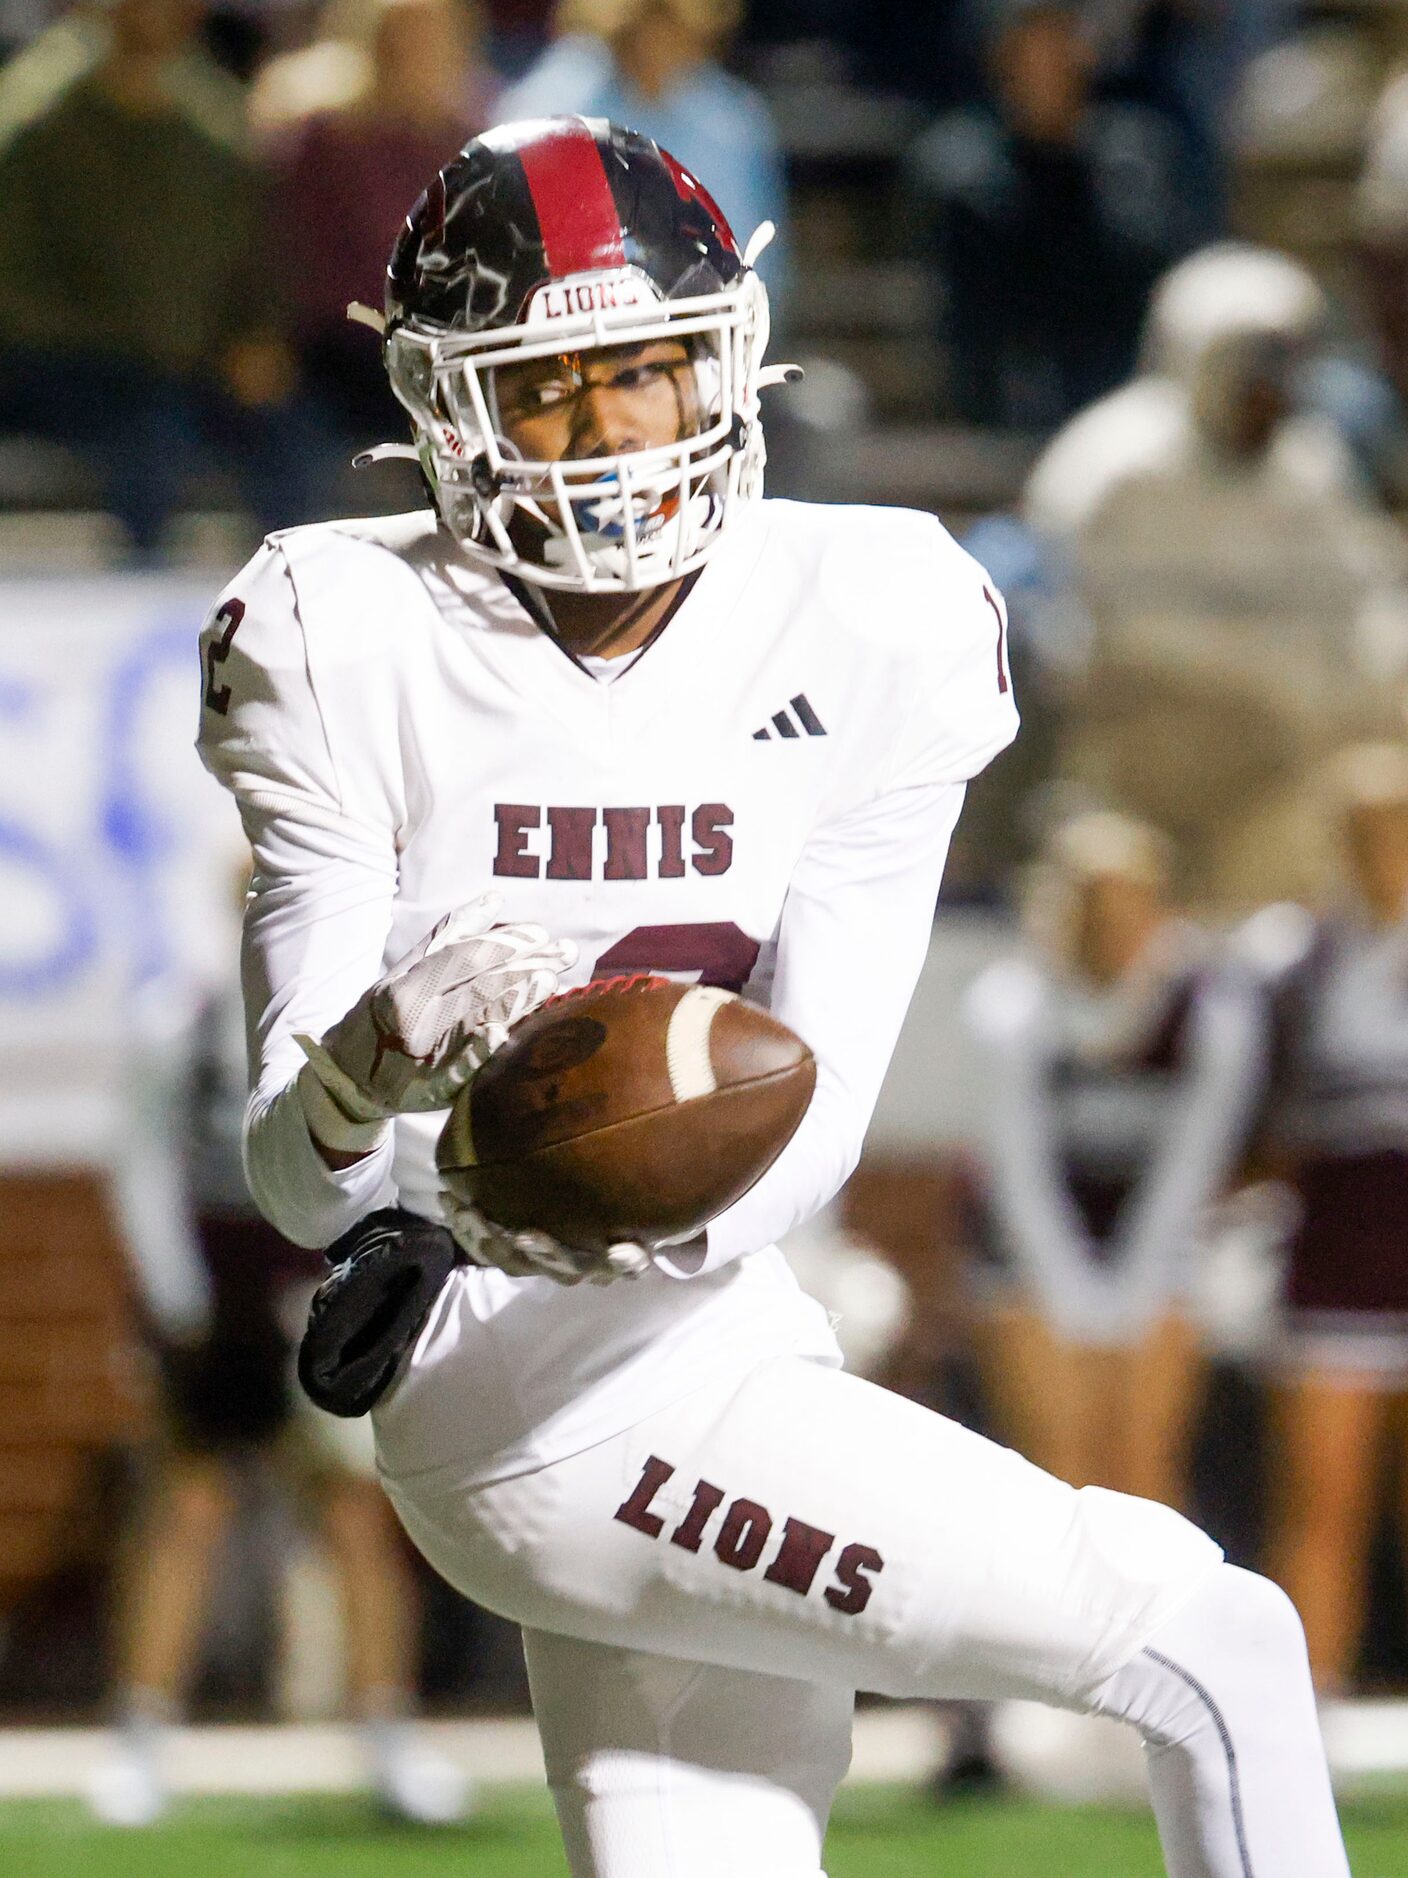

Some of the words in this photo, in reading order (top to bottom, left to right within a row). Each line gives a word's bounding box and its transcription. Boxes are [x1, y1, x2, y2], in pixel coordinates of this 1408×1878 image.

[205, 597, 246, 716] 2
[491, 802, 735, 881] ENNIS
[612, 1454, 885, 1617] LIONS
